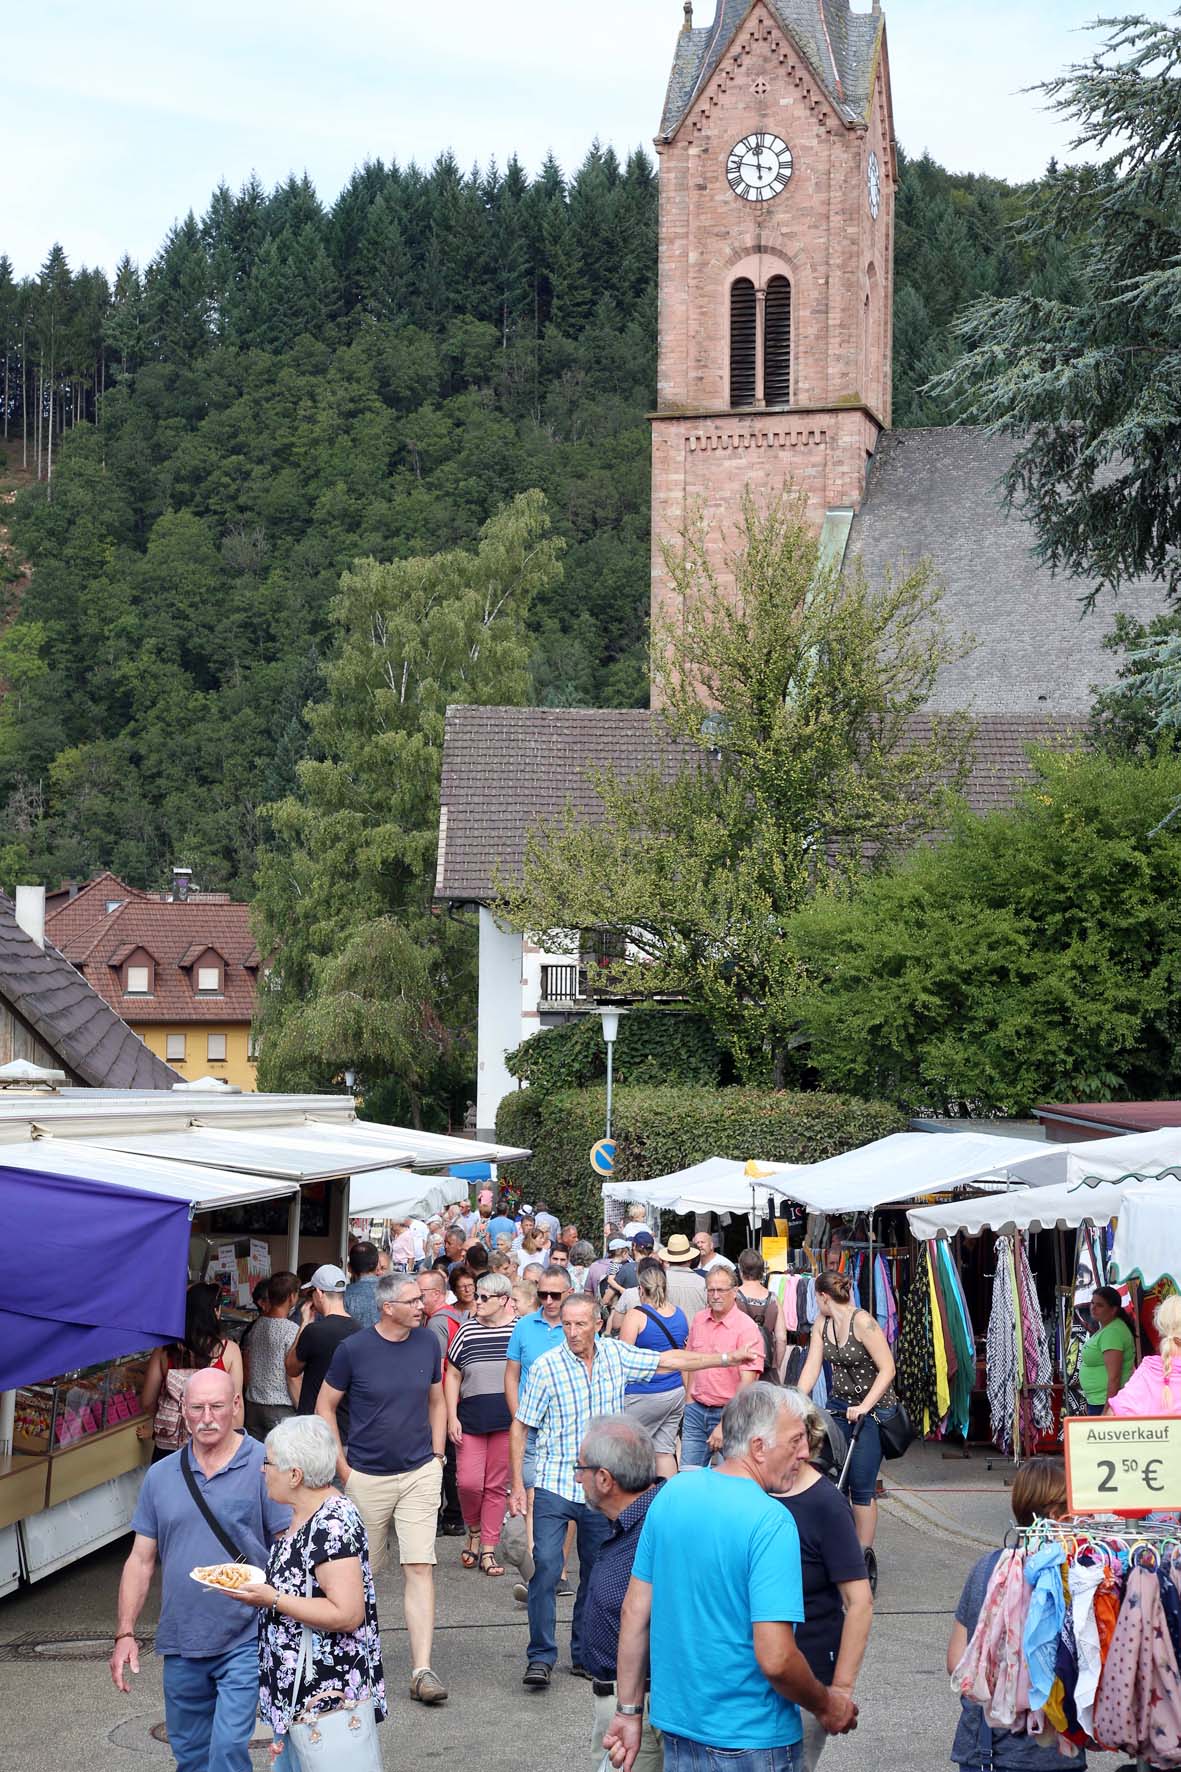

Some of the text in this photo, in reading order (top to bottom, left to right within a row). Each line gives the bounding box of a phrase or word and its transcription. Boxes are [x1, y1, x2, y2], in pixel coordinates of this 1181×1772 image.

[1087, 1426, 1169, 1441] Ausverkauf
[1097, 1459, 1165, 1492] 2 50 €
